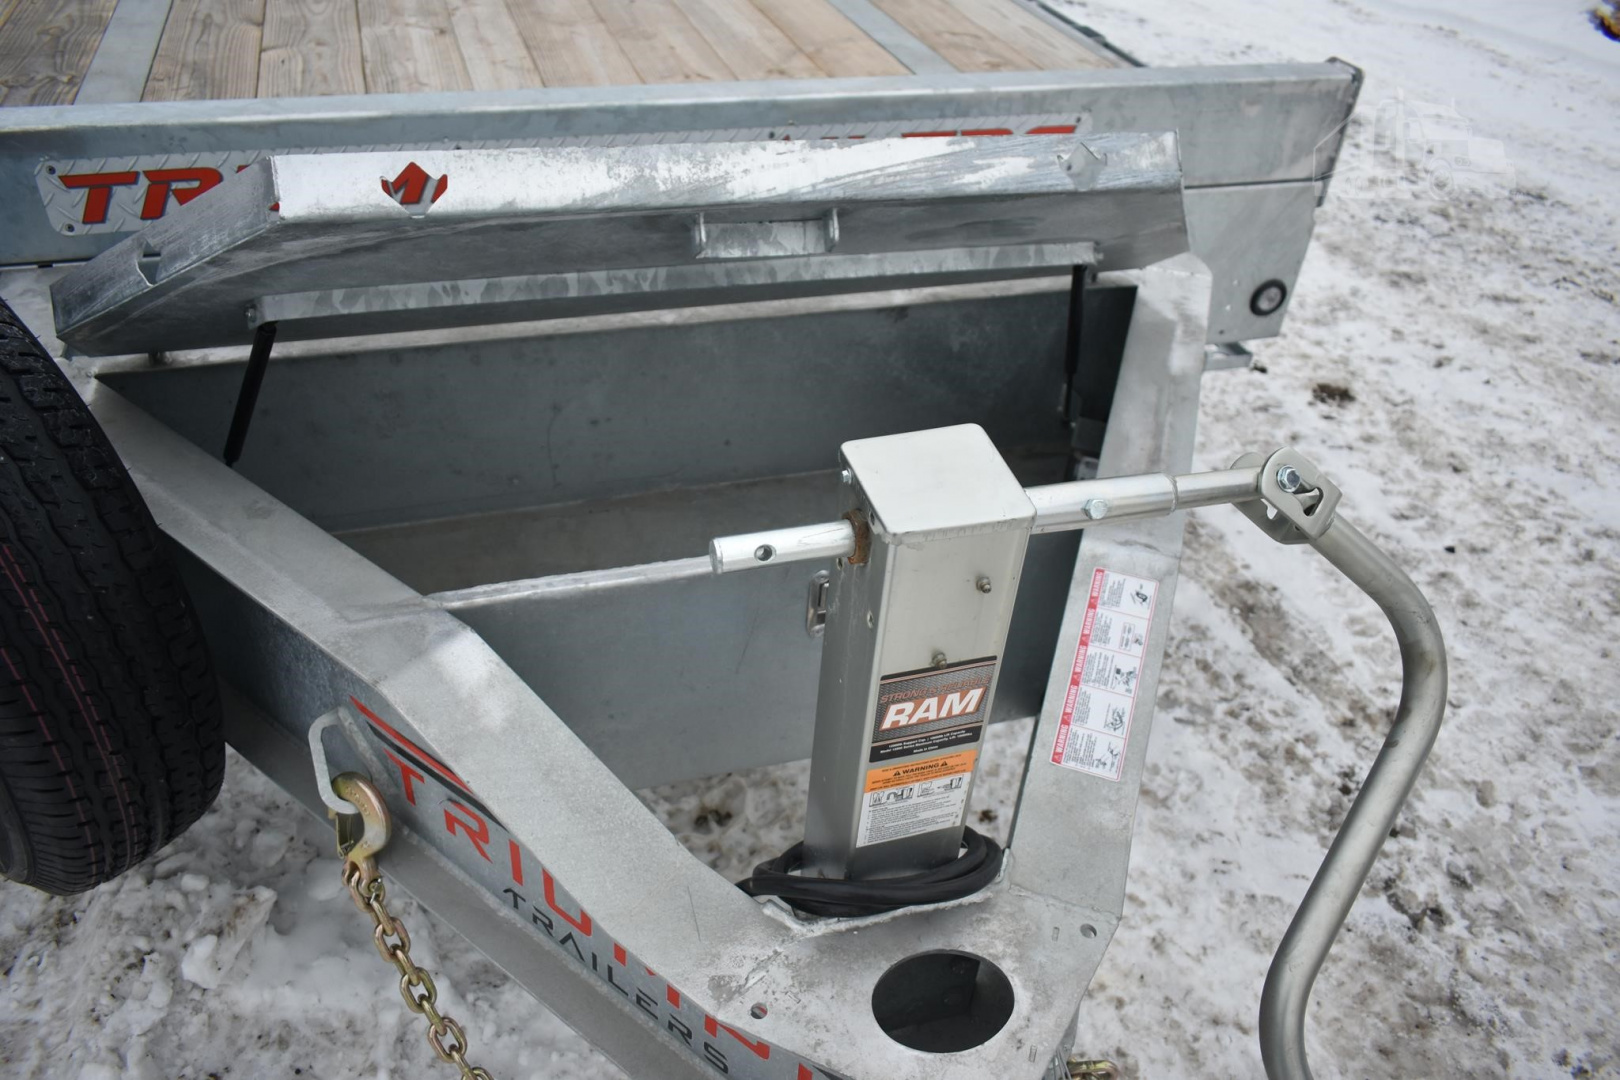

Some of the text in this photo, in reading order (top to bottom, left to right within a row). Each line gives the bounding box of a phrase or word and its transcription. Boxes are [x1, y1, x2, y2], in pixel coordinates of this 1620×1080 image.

[1091, 571, 1104, 597] WARNING
[1083, 608, 1096, 634] WARNING
[1074, 646, 1088, 672] WARNING
[881, 688, 927, 703] STRONG
[881, 687, 984, 730] RAM
[1065, 685, 1079, 712] WARNING
[1056, 724, 1069, 753] WARNING
[902, 762, 940, 775] WARNING
[503, 888, 729, 1074] TRAILERS
